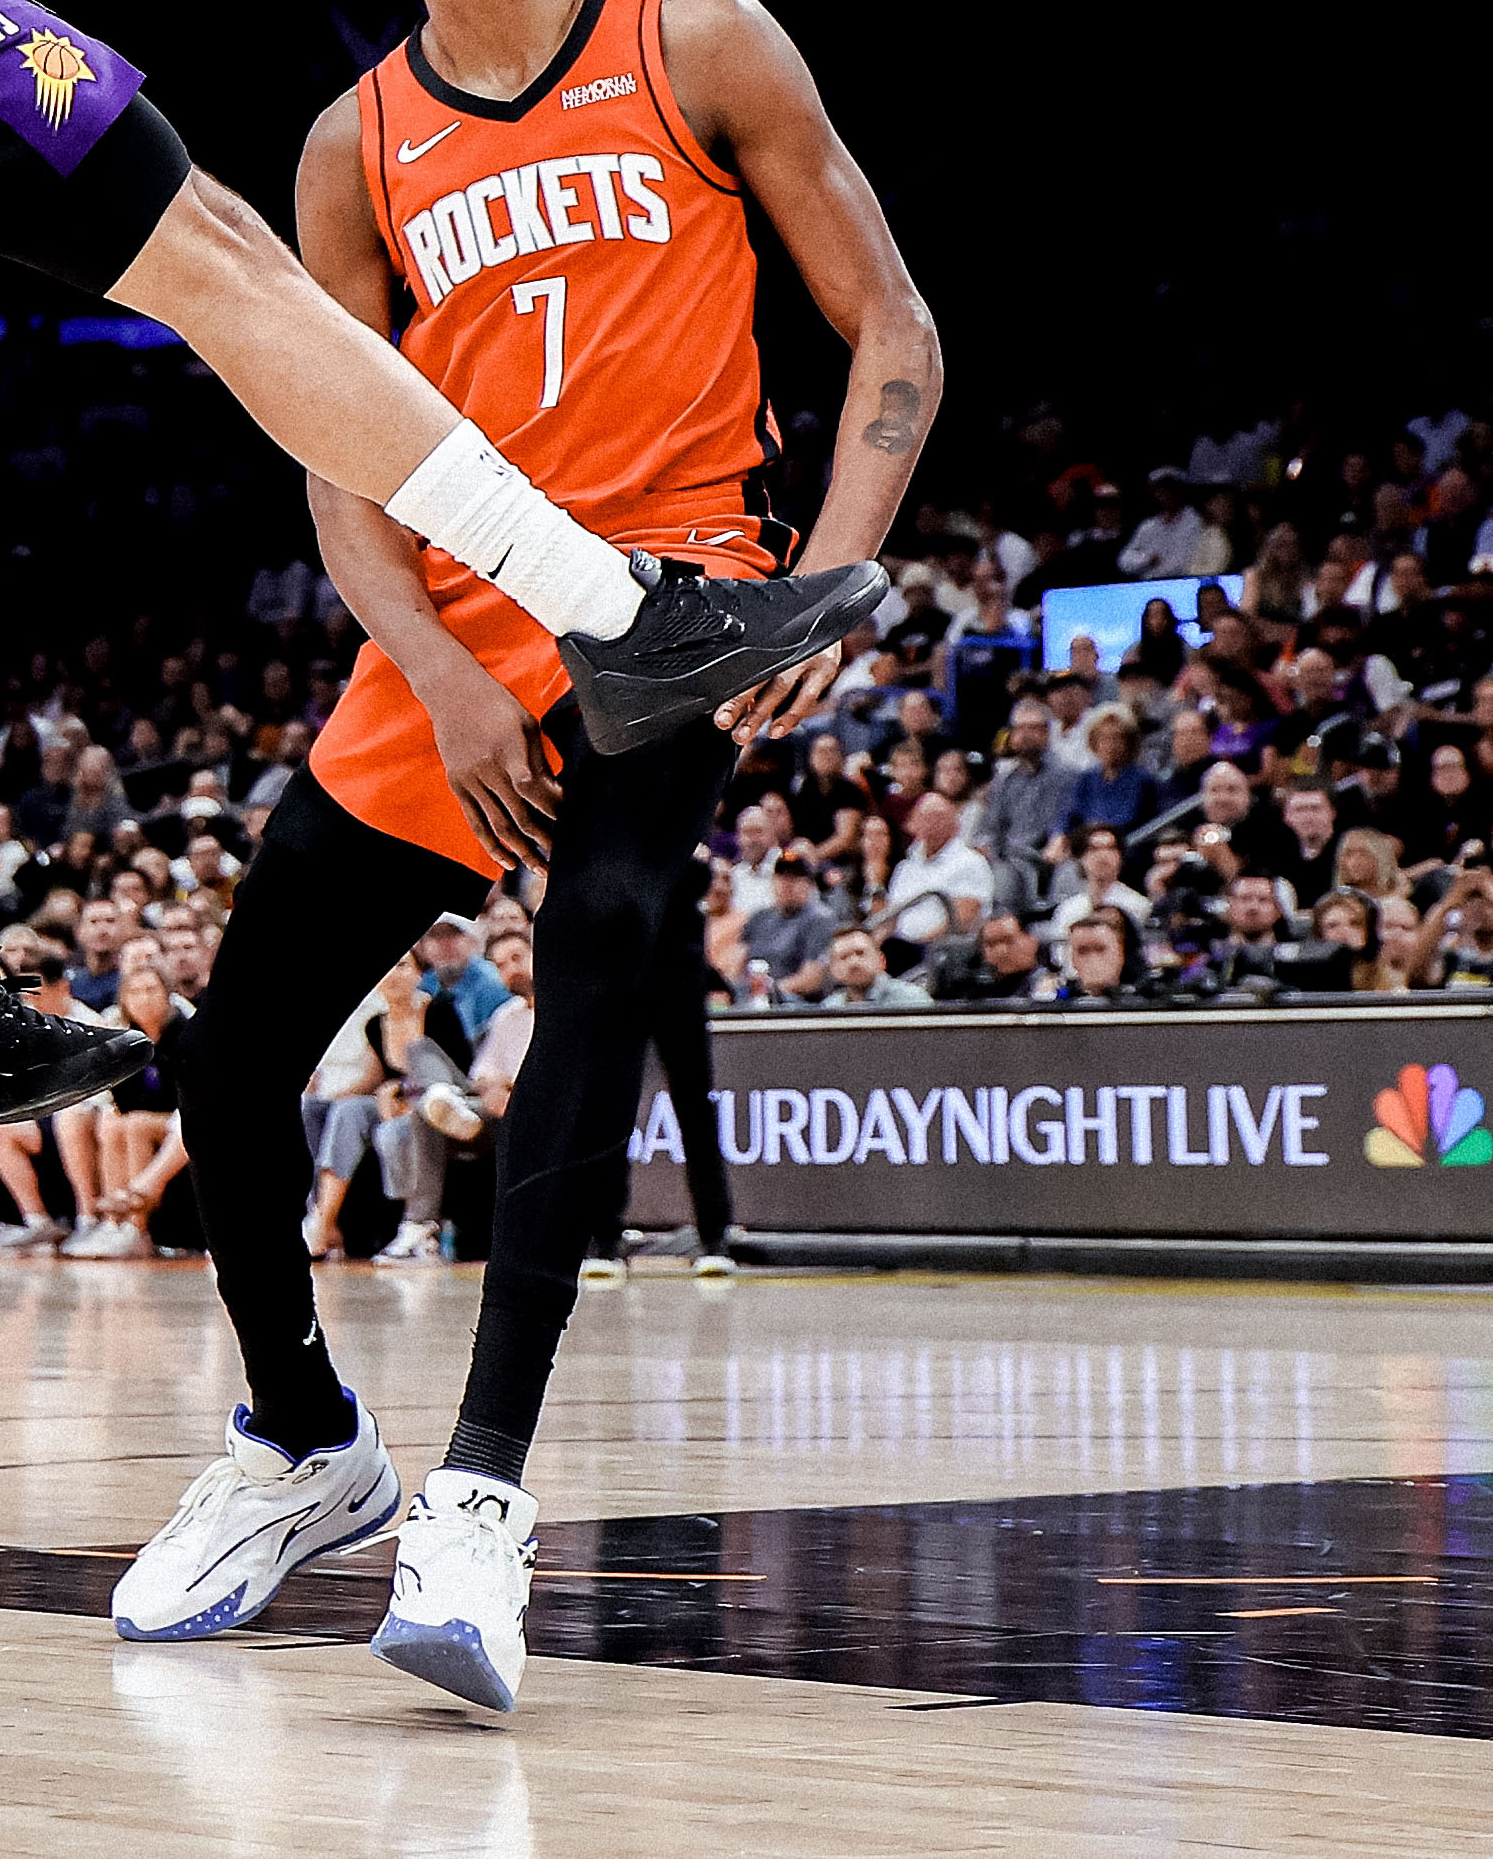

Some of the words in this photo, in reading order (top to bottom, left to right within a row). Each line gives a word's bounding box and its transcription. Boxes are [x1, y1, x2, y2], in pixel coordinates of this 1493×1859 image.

[560, 72, 635, 101] MEMORIAL
[561, 80, 637, 110] HERMANN
[403, 152, 671, 308] ROCKETS
[510, 275, 566, 409] 7
[626, 1083, 1329, 1167] AURDAYNIGHTLIVE
